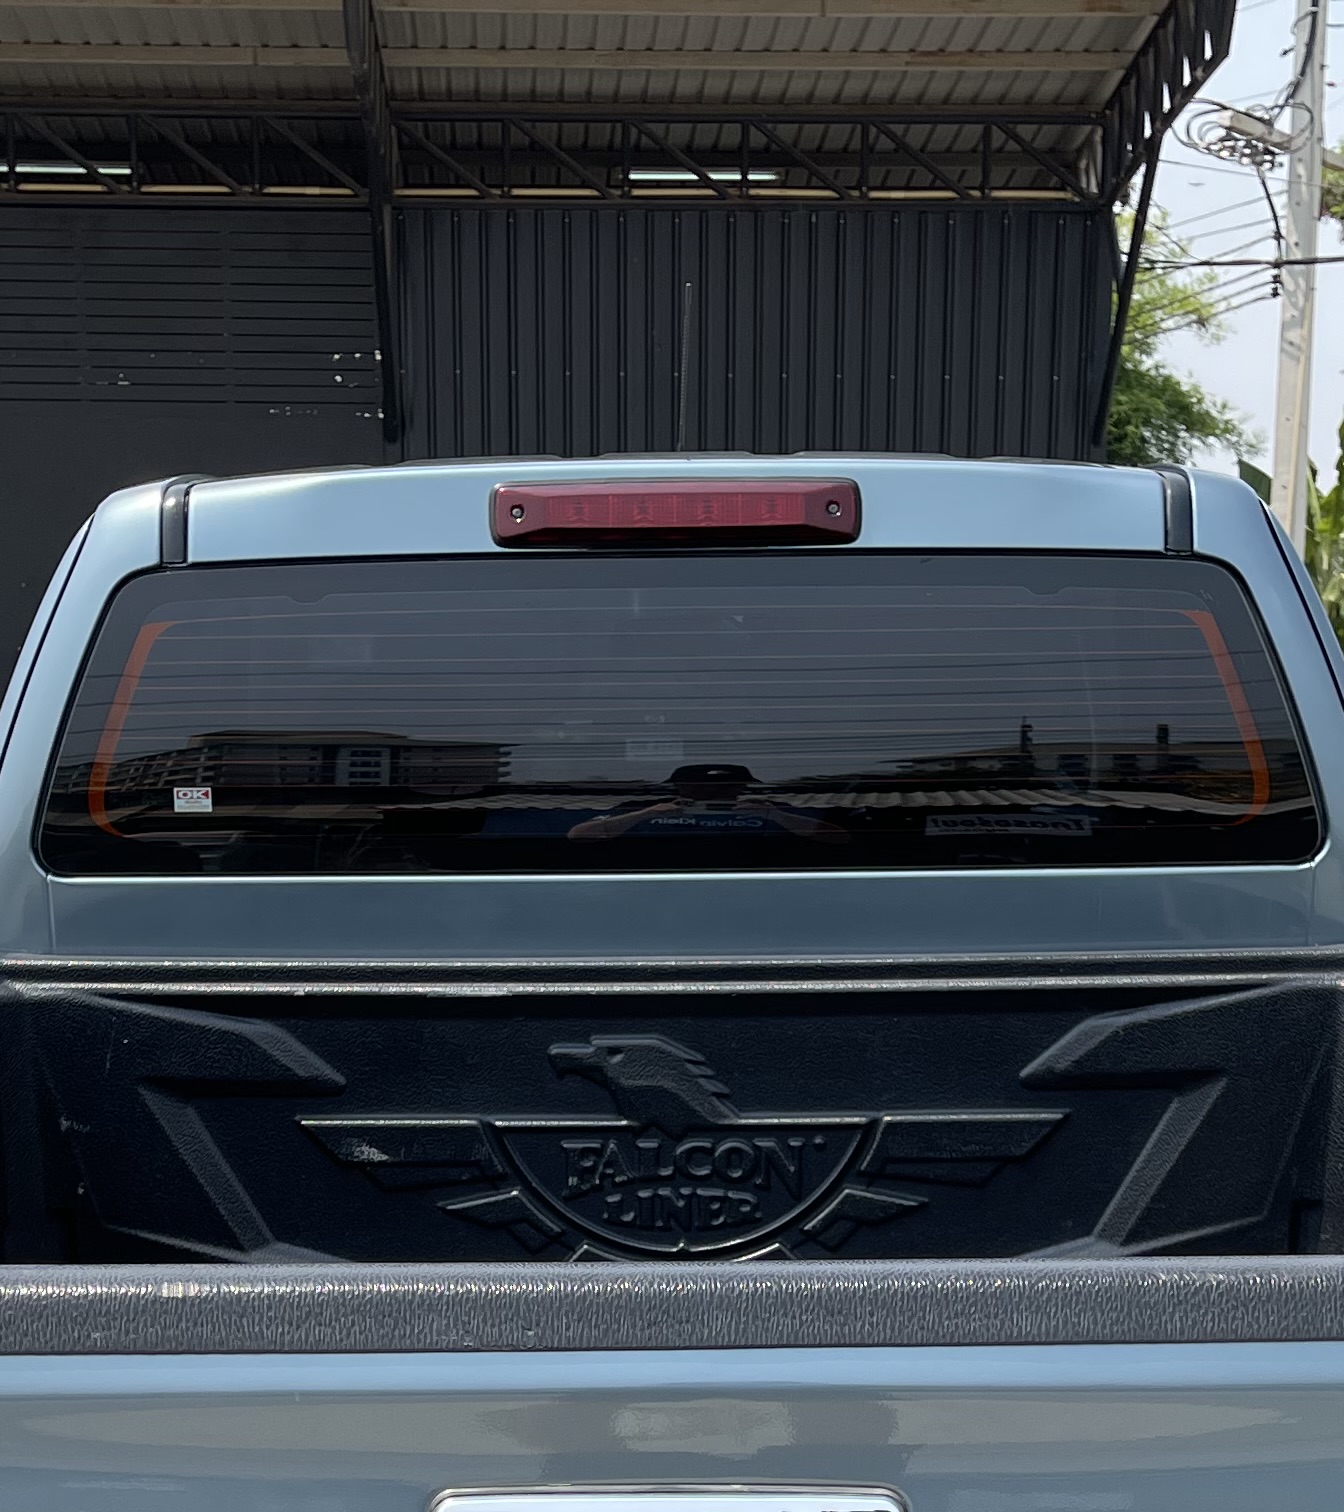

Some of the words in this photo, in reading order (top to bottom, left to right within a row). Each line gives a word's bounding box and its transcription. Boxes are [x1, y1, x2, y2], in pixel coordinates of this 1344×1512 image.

[177, 789, 209, 800] OK
[561, 1137, 805, 1202] FALCON
[603, 1186, 764, 1232] LINER
